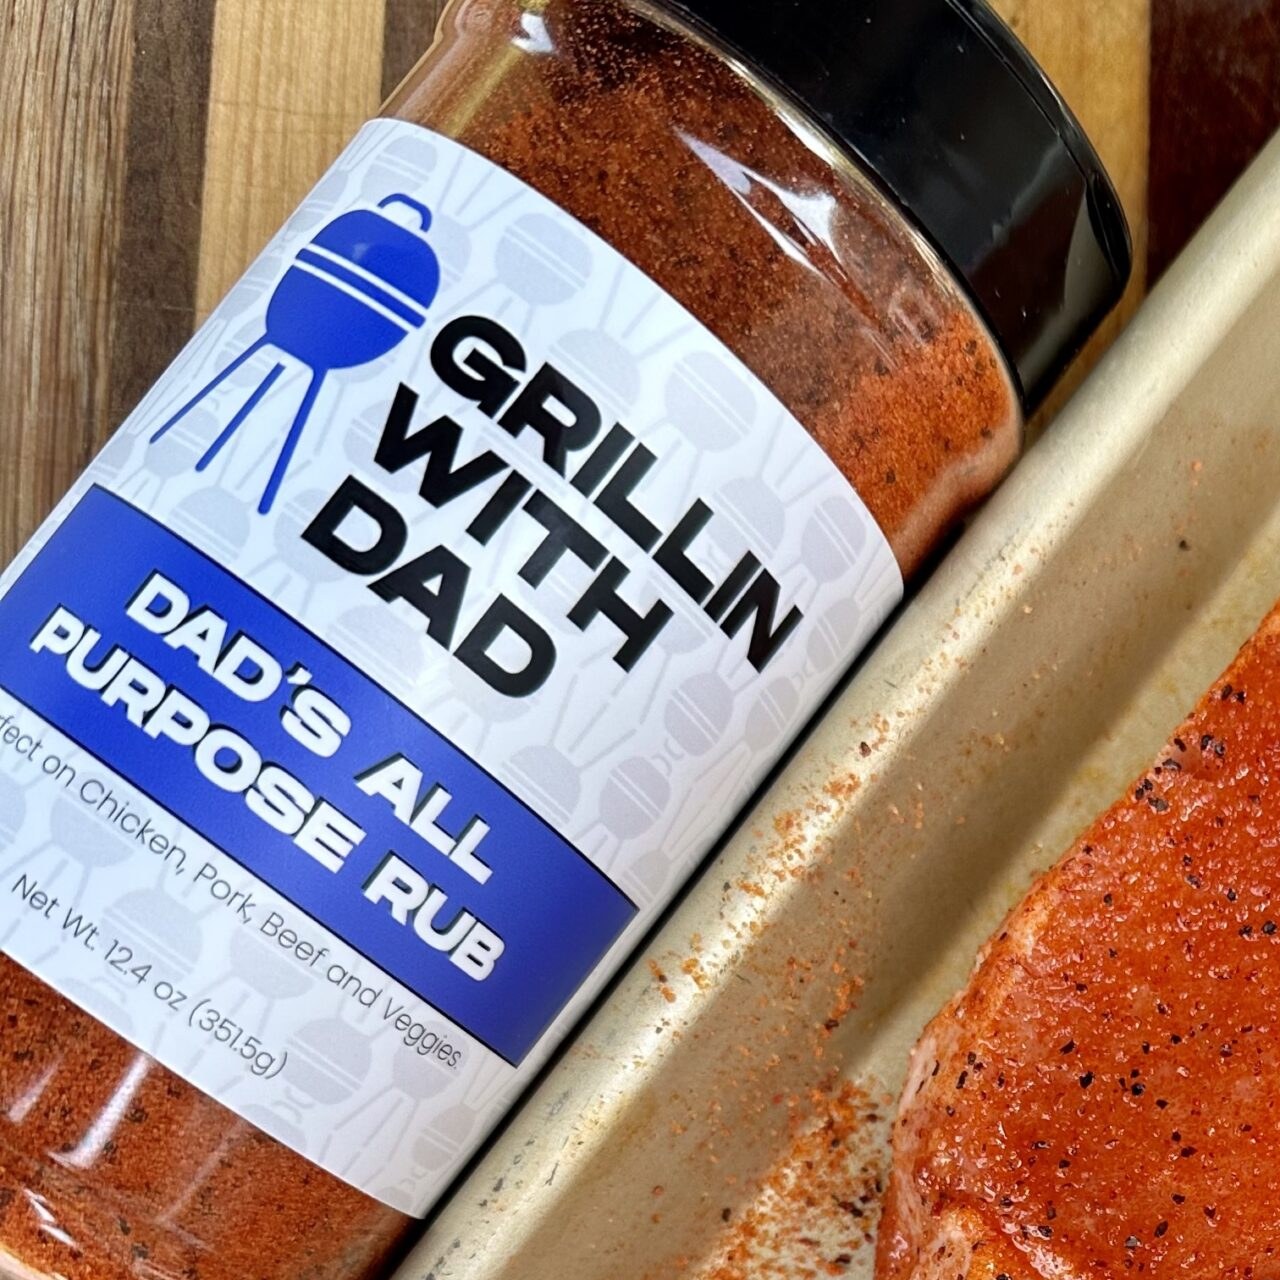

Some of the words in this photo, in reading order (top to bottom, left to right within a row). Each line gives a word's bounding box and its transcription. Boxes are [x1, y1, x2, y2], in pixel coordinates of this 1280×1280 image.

[301, 474, 557, 698] DAD
[373, 382, 675, 673] WITH
[430, 315, 804, 674] GRILLIN
[28, 603, 367, 874] PURPOSE
[361, 849, 505, 982] RUB
[42, 755, 76, 787] on
[80, 778, 187, 876] Chicken,
[193, 862, 256, 924] Pork,
[259, 911, 330, 967] Beef
[326, 964, 383, 1008] and
[354, 752, 493, 886] ALL
[11, 874, 60, 919] Net
[62, 907, 101, 951] Wt.
[104, 939, 153, 984] 12.4
[153, 980, 188, 1012] oz
[188, 998, 288, 1080] (351.5g)
